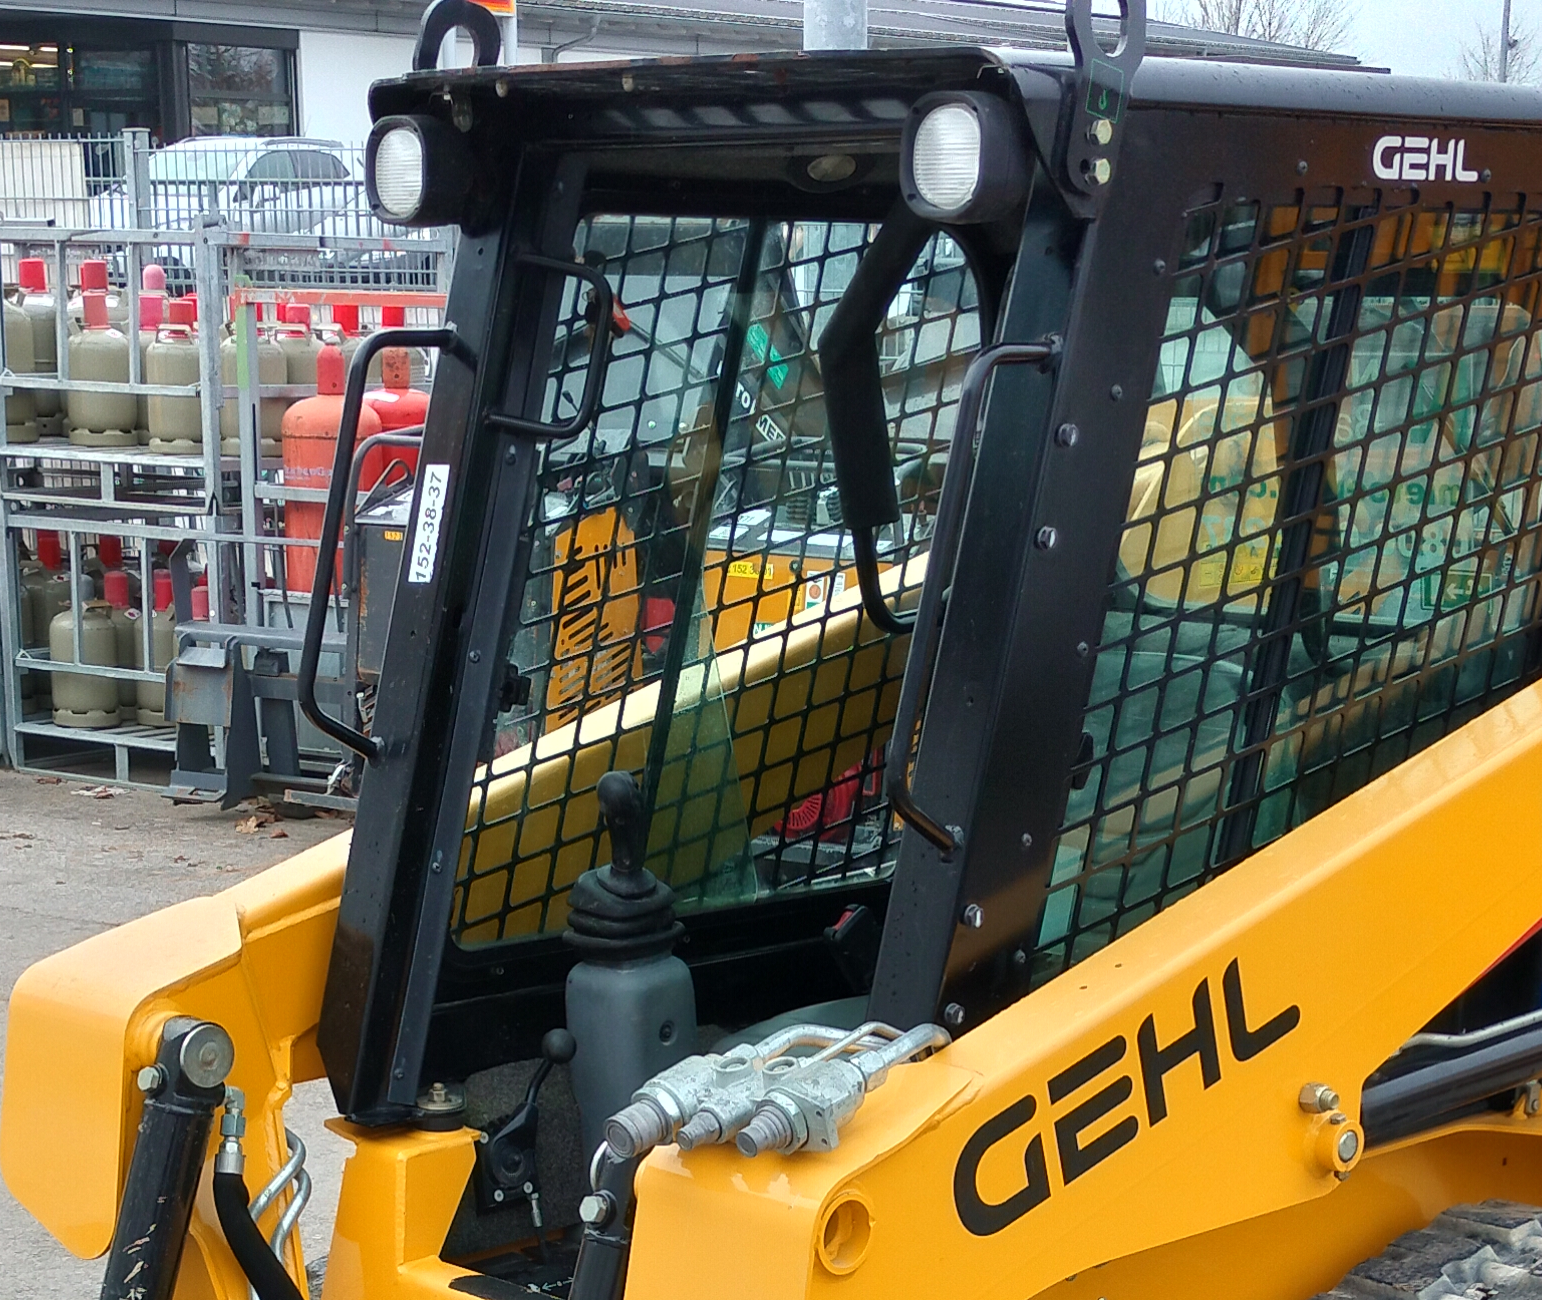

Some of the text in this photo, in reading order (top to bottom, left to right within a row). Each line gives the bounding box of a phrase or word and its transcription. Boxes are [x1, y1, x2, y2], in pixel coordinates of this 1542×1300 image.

[1372, 135, 1479, 182] GEHL
[415, 471, 443, 581] 152-38-37
[953, 956, 1301, 1237] GEHL
